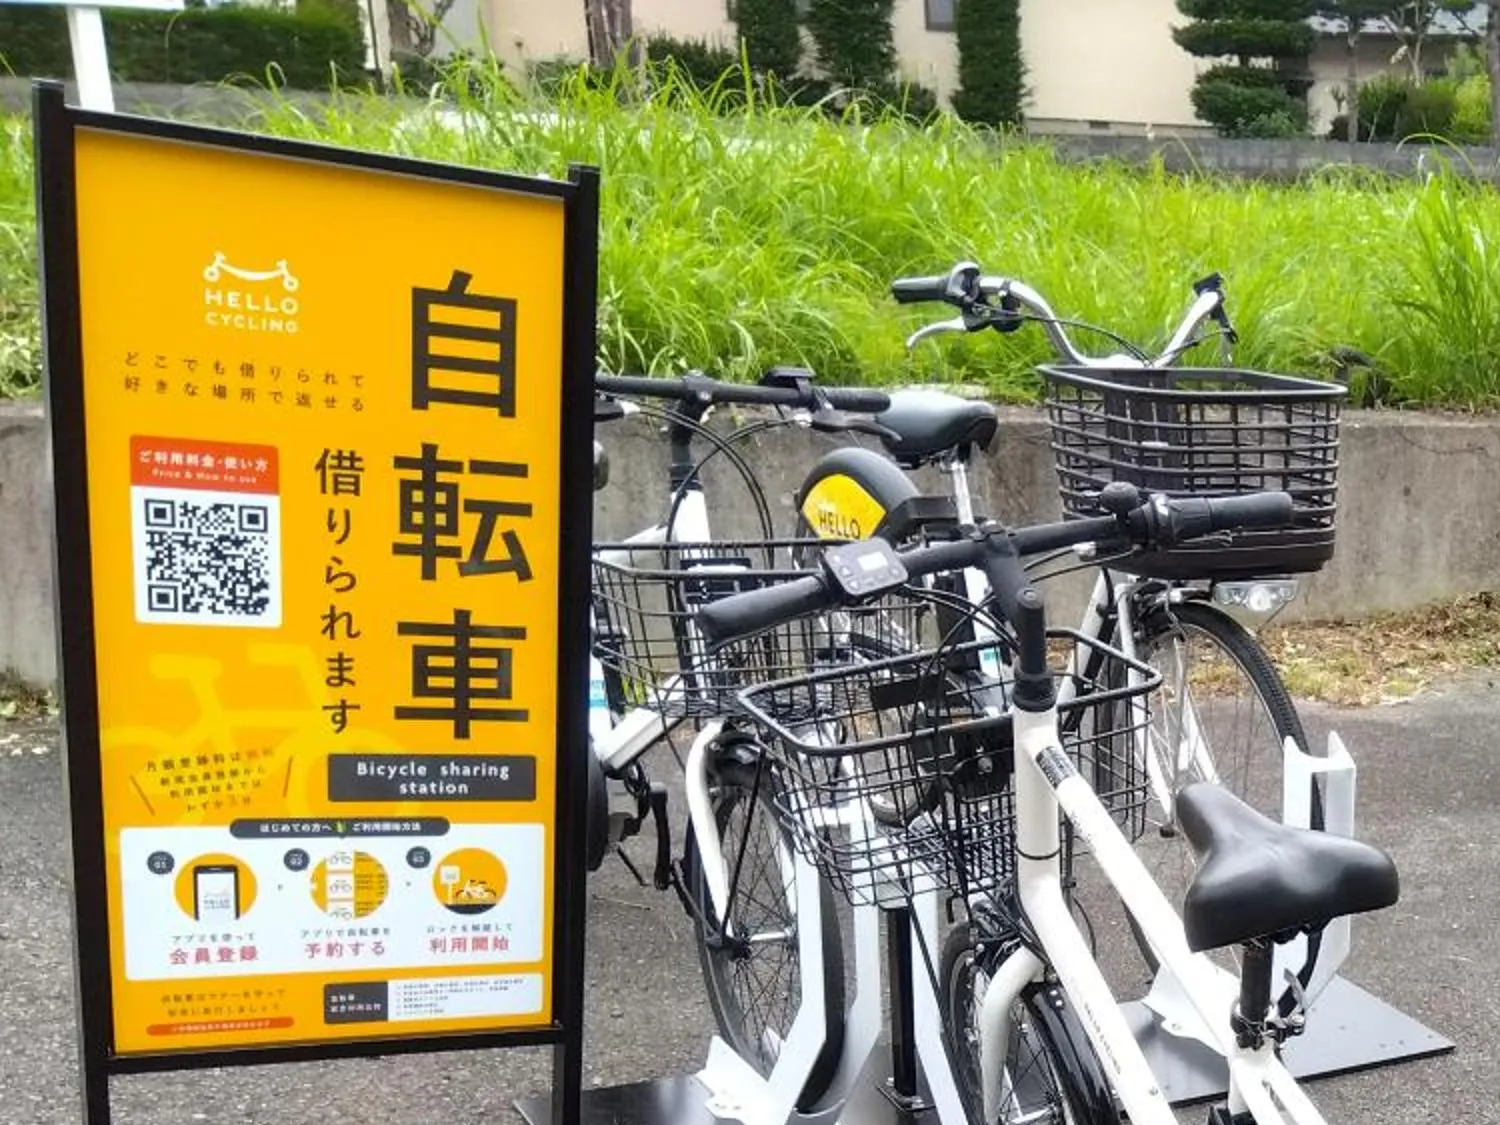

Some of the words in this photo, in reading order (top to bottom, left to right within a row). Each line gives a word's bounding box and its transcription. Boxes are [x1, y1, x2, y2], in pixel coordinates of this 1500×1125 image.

[204, 288, 299, 315] HELLO
[205, 311, 298, 334] CYCLING
[124, 351, 365, 388] どこでも借りられて
[124, 376, 364, 413] 好きな場所で返せる
[391, 269, 534, 740] 自転車
[818, 510, 862, 540] HELLO
[314, 448, 366, 734] 借りられます
[356, 762, 428, 780] Bicycle
[440, 762, 510, 780] sharing
[399, 781, 470, 795] station
[169, 945, 258, 965] 会員登録
[304, 941, 386, 959] 予約する
[429, 935, 510, 954] 利用開始
